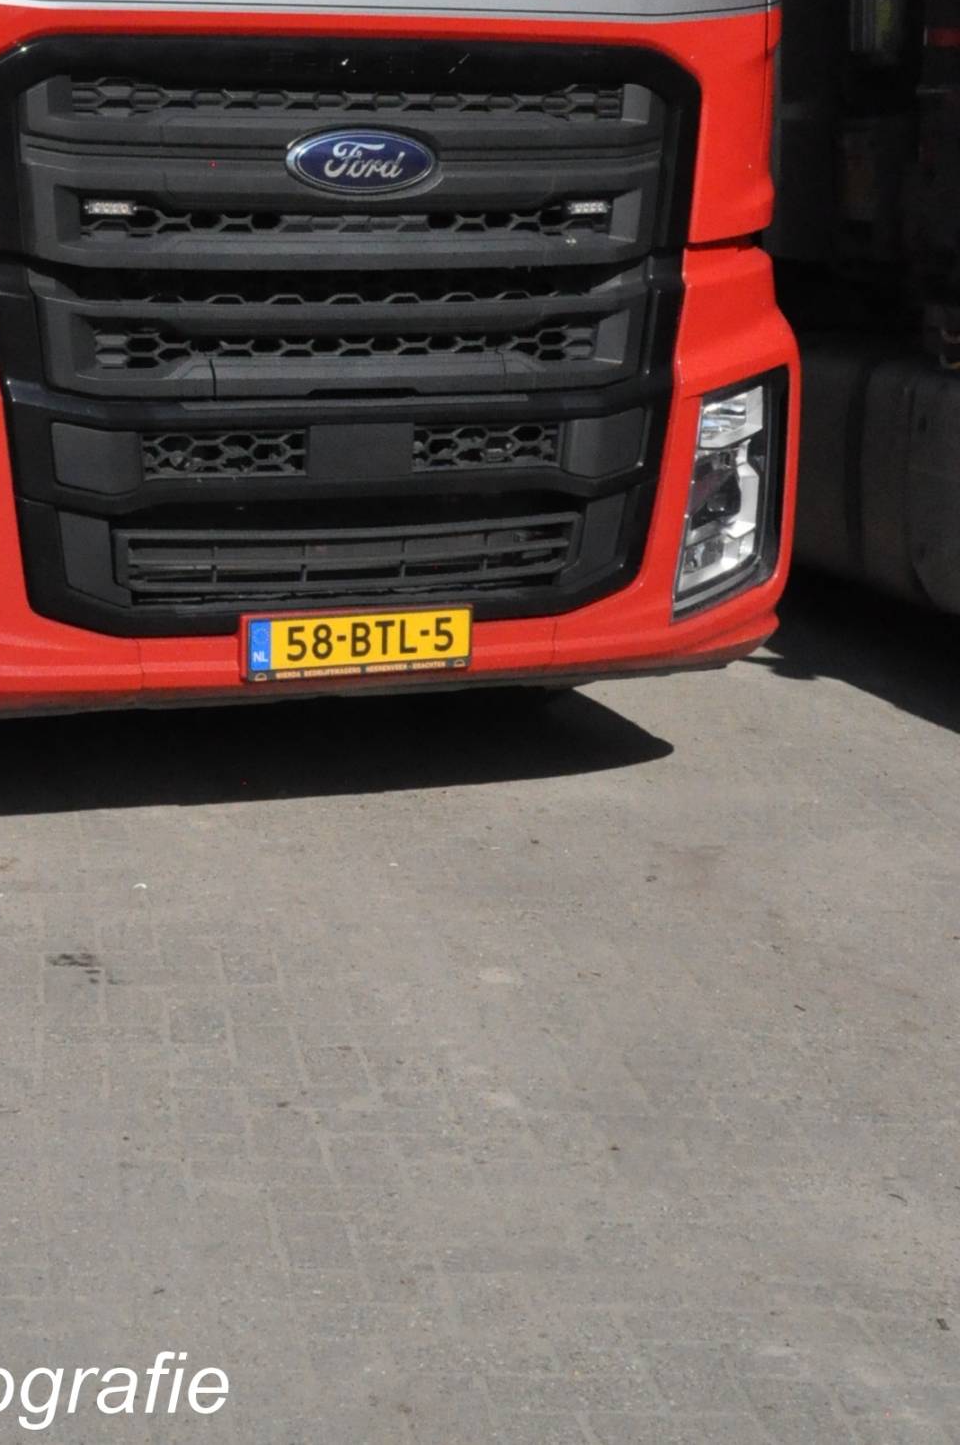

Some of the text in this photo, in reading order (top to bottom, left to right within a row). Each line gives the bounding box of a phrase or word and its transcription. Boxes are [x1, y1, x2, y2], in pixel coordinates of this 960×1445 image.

[324, 141, 403, 180] Ford
[253, 651, 268, 663] NL
[286, 616, 455, 662] 58-BTL-5
